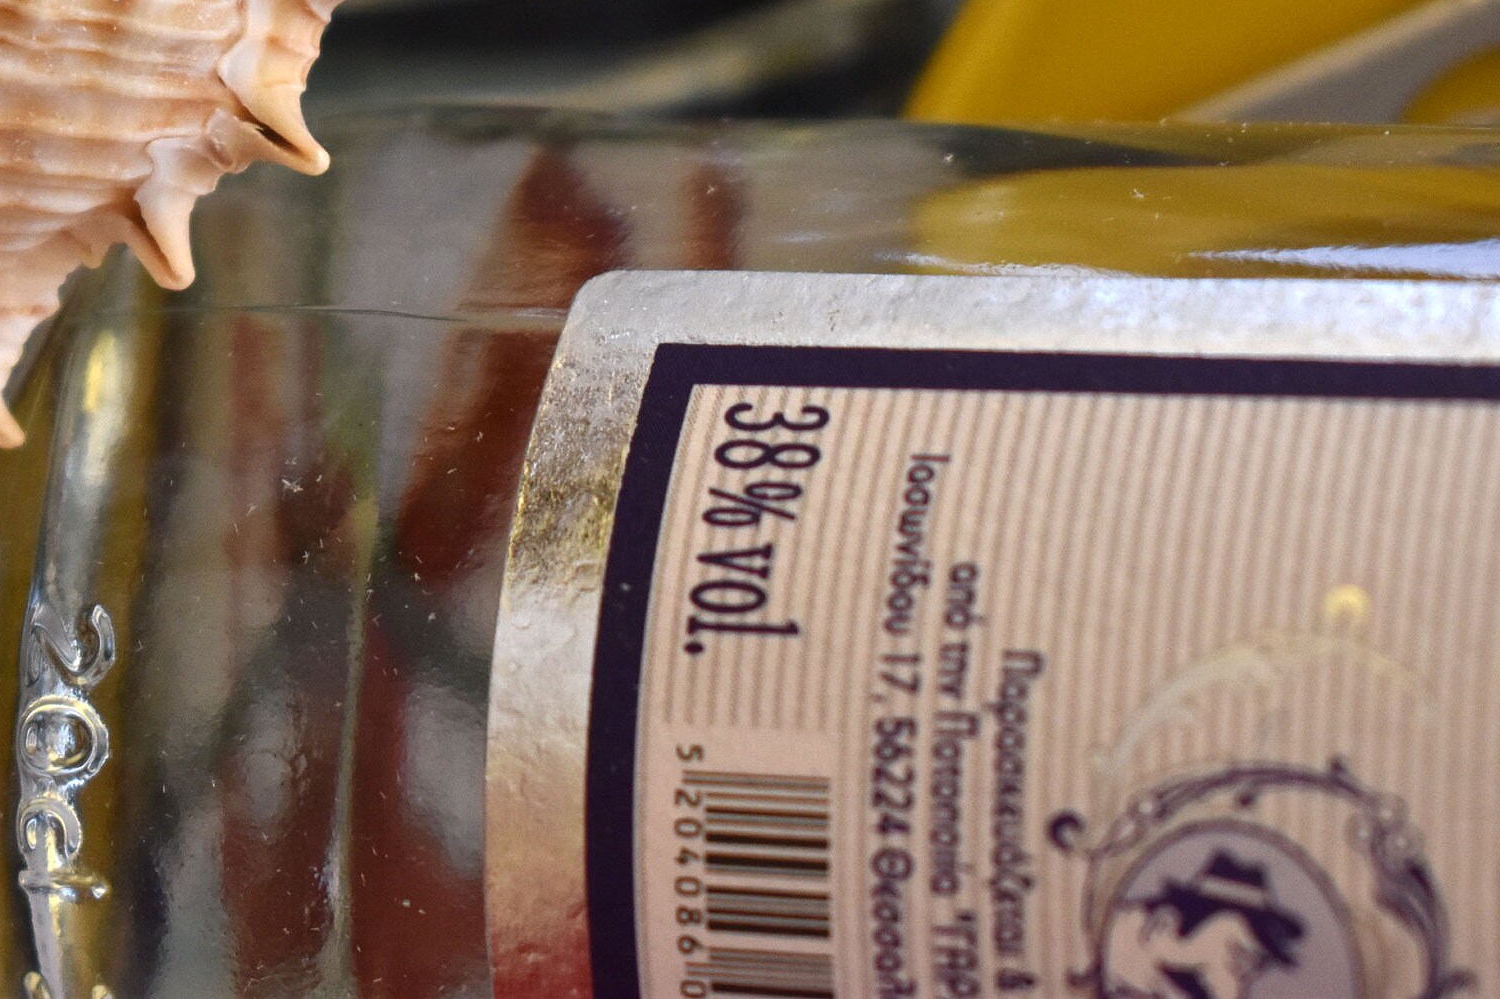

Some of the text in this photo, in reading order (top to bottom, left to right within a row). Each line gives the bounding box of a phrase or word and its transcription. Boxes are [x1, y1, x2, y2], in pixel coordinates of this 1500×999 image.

[682, 402, 831, 658] 38% vol.
[675, 743, 705, 763] 5
[873, 716, 915, 835] 56224
[674, 789, 705, 956] 204086
